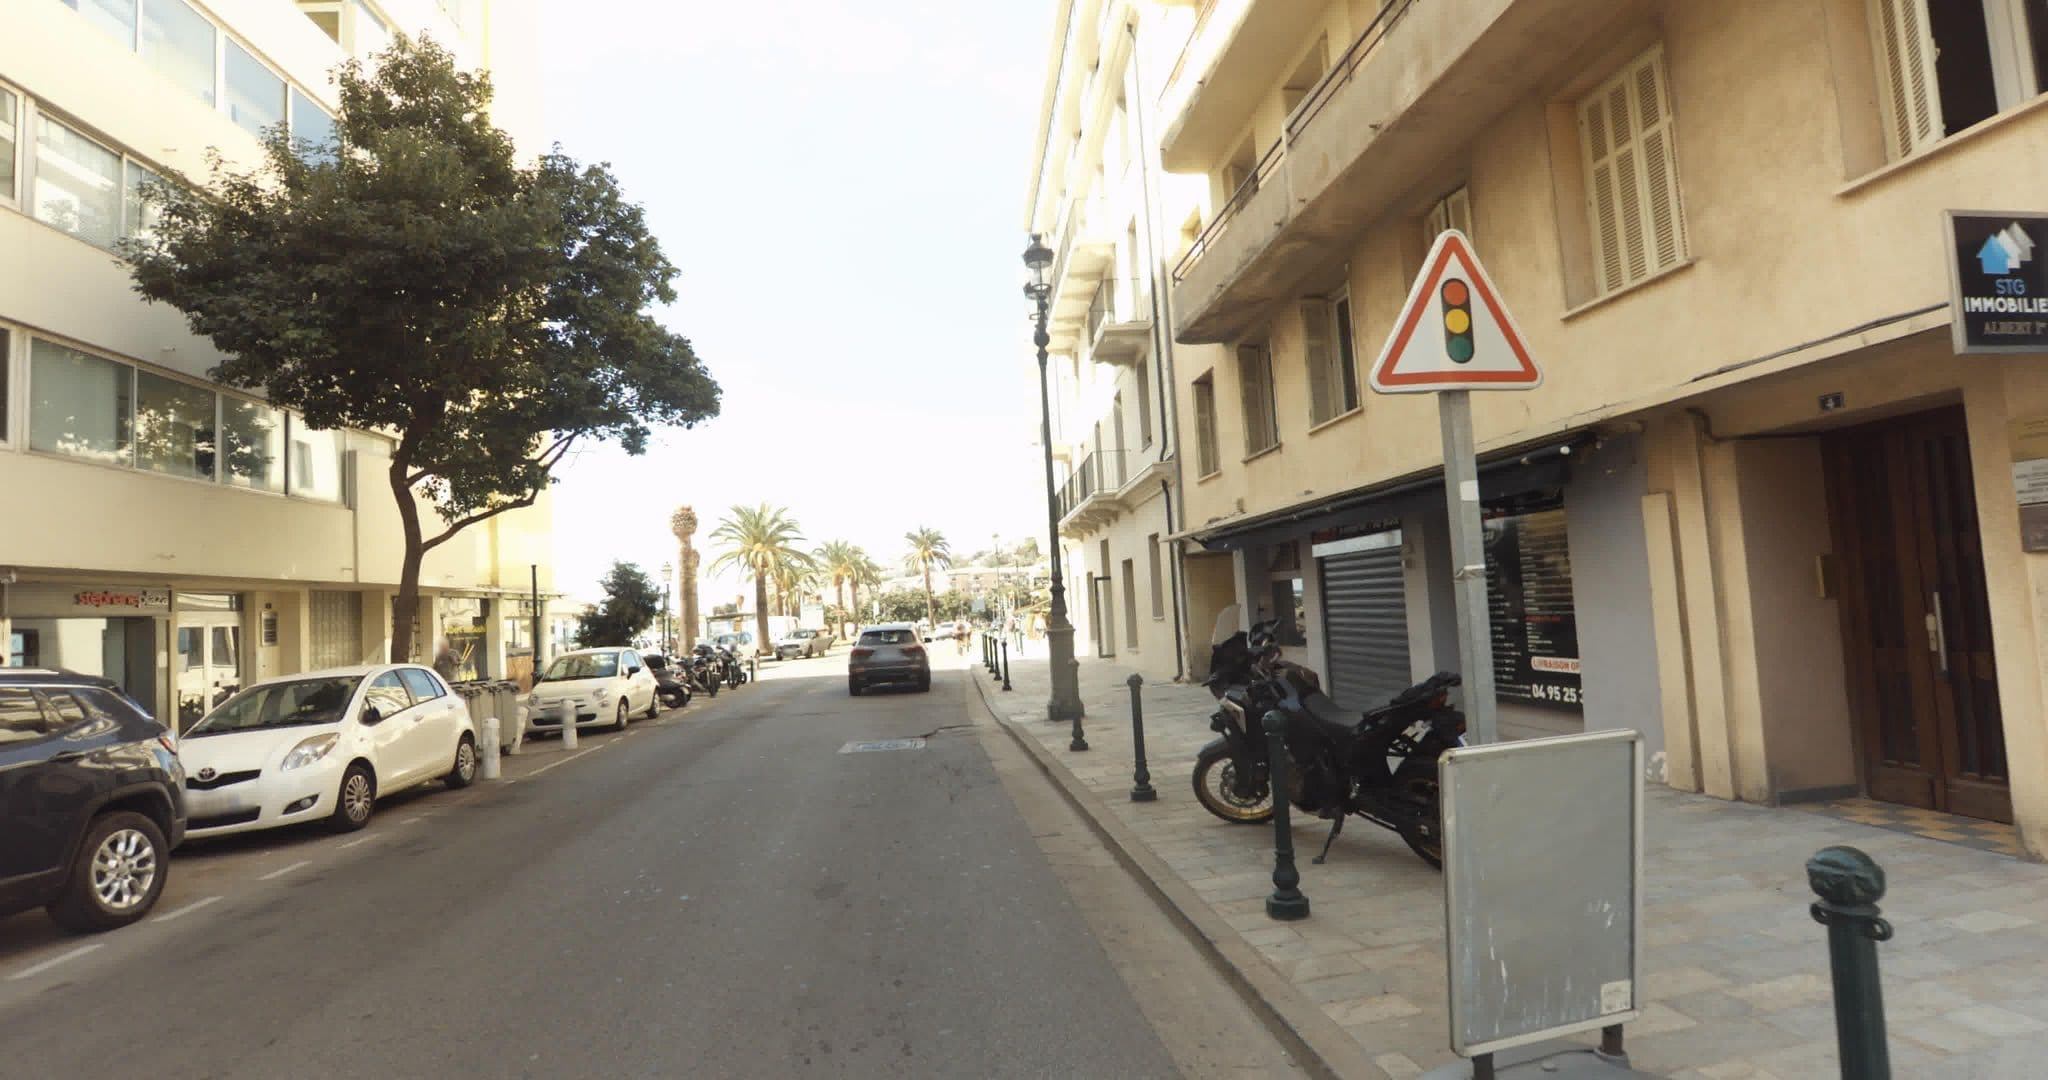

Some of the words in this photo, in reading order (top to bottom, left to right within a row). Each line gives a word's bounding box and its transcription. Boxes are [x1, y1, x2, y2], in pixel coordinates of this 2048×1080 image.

[1995, 278, 2026, 295] STG
[1532, 683, 1546, 699] 04
[1547, 685, 1561, 701] 95
[1562, 686, 1577, 703] 25
